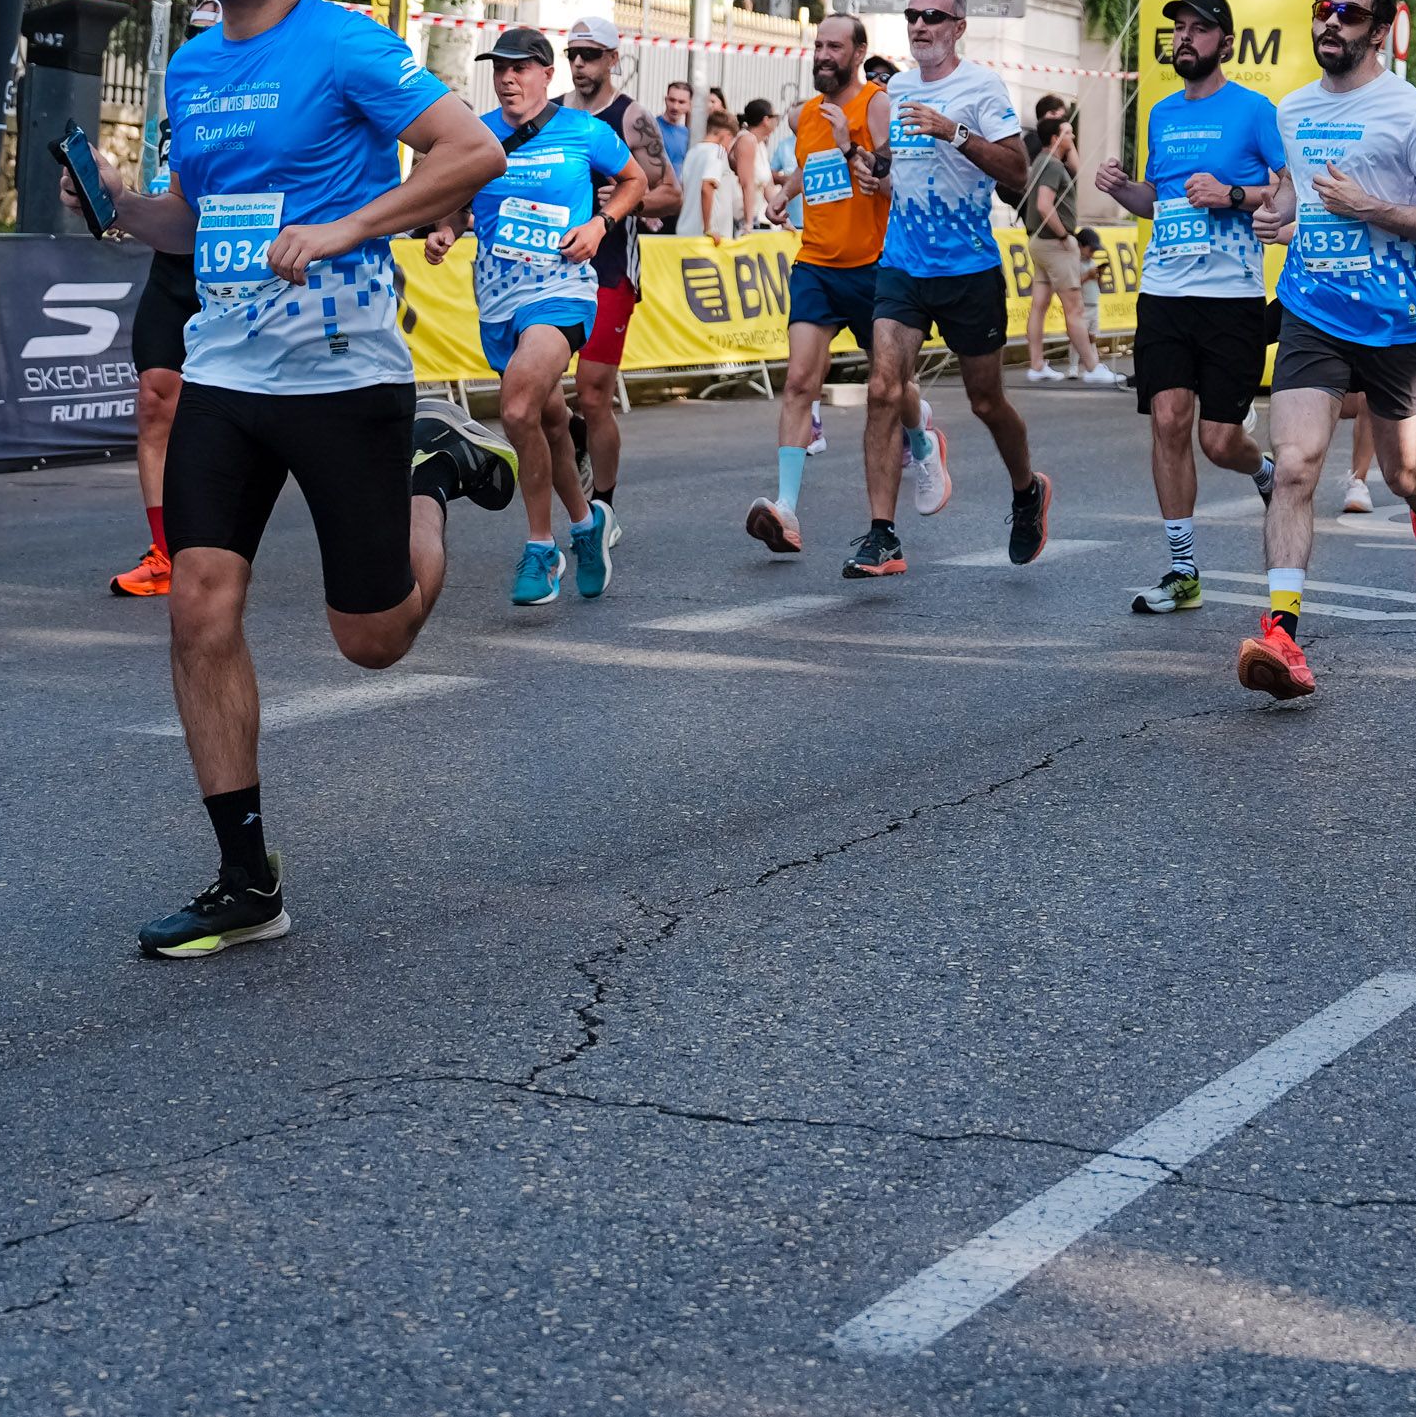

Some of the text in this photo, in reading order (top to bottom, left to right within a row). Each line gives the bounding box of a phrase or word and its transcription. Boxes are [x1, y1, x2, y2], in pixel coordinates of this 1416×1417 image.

[34, 32, 65, 47] 047
[1221, 28, 1281, 65] M
[251, 93, 279, 109] SUR
[195, 120, 255, 141] Run Well
[1166, 145, 1185, 154] Run
[1302, 146, 1323, 157] Run
[805, 169, 847, 191] 2711
[235, 204, 252, 212] Dutch
[499, 222, 561, 250] 4280
[1158, 220, 1207, 242] 2959
[1301, 229, 1363, 252] 4337
[199, 239, 272, 273] 1934
[50, 398, 135, 423] RUNNING
